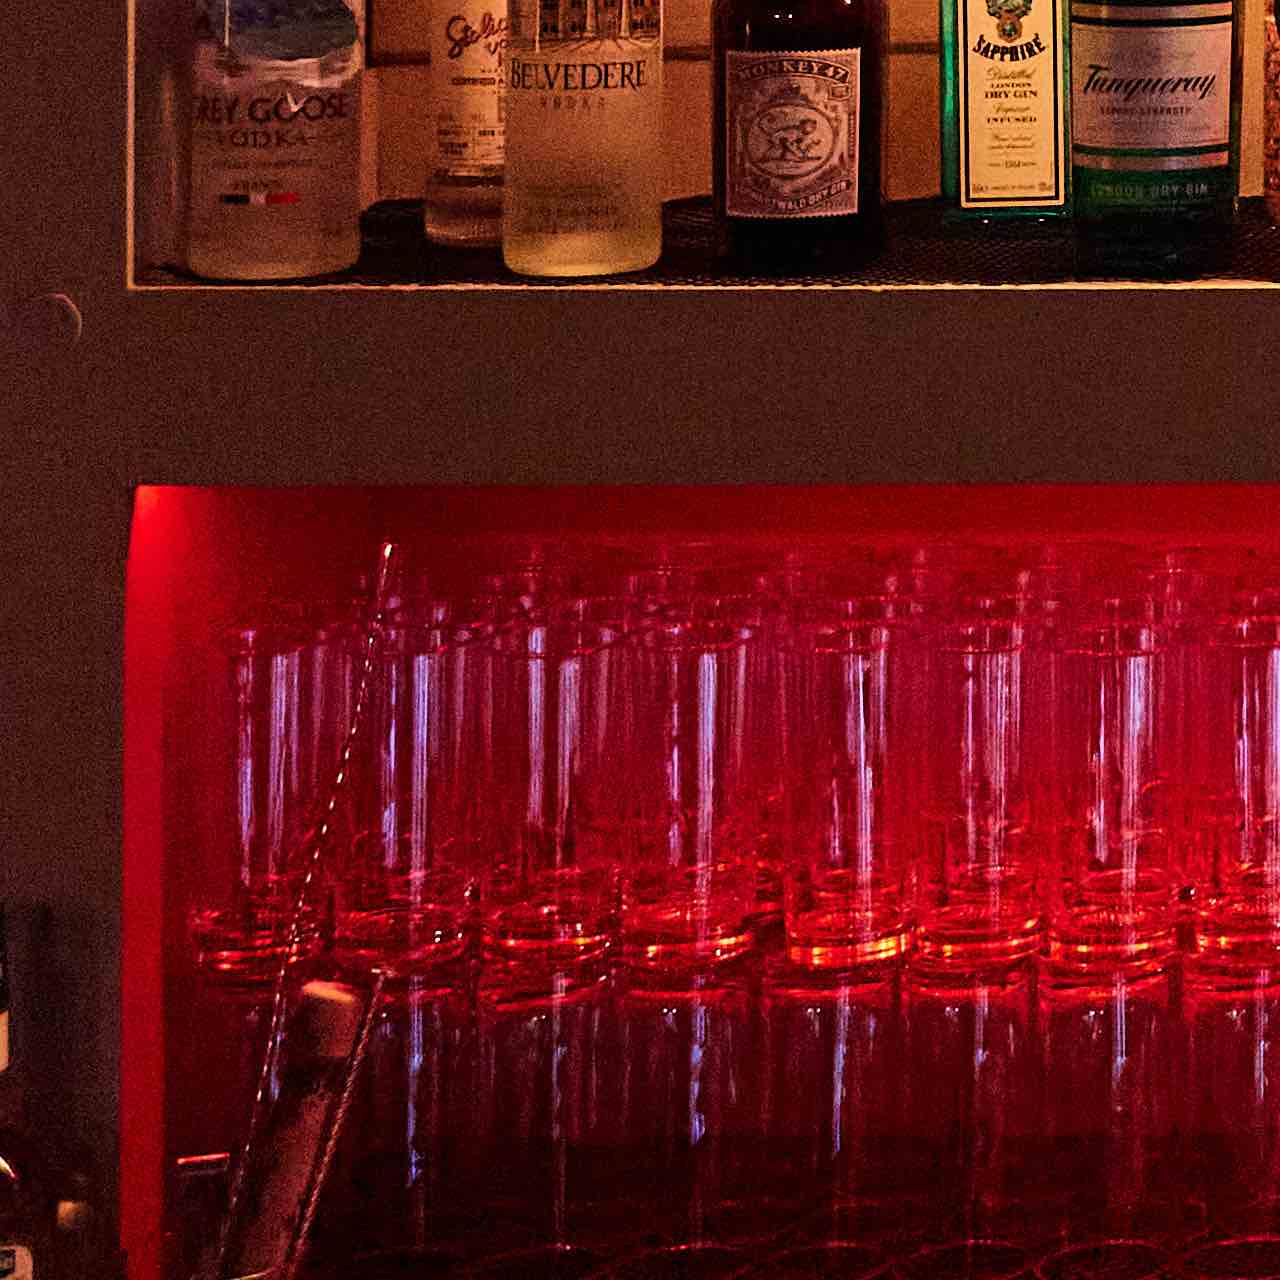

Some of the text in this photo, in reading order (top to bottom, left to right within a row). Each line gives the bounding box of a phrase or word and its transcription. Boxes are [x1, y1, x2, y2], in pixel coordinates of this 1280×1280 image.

[972, 32, 1047, 63] SAPPHIRE
[511, 57, 648, 93] BELVEDERE
[823, 65, 850, 82] 47
[991, 81, 1033, 89] LONDON
[1083, 63, 1217, 102] Tanqueray
[249, 93, 347, 122] GOOSE
[984, 90, 1038, 99] DRY GIN
